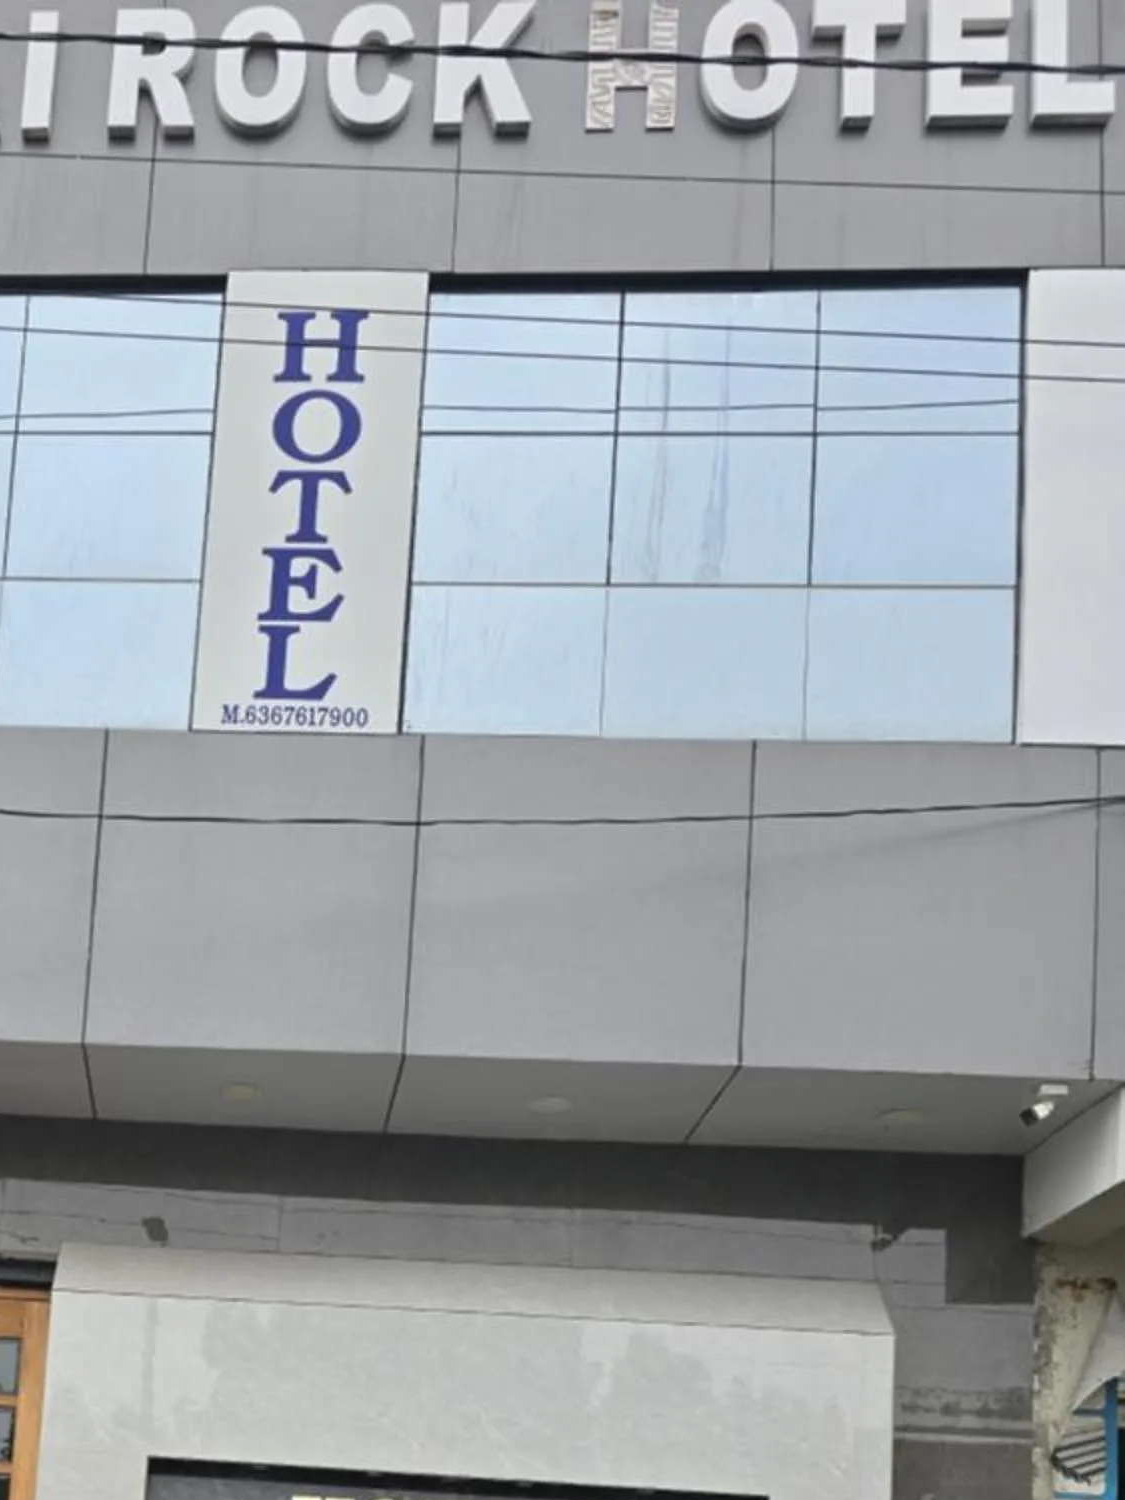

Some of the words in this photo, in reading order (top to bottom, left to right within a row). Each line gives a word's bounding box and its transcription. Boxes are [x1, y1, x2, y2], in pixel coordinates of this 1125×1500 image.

[106, 0, 537, 140] ROCK
[584, 0, 1116, 132] HOTEL
[253, 309, 369, 701] HOTEL
[220, 703, 369, 728] M.6367617900
